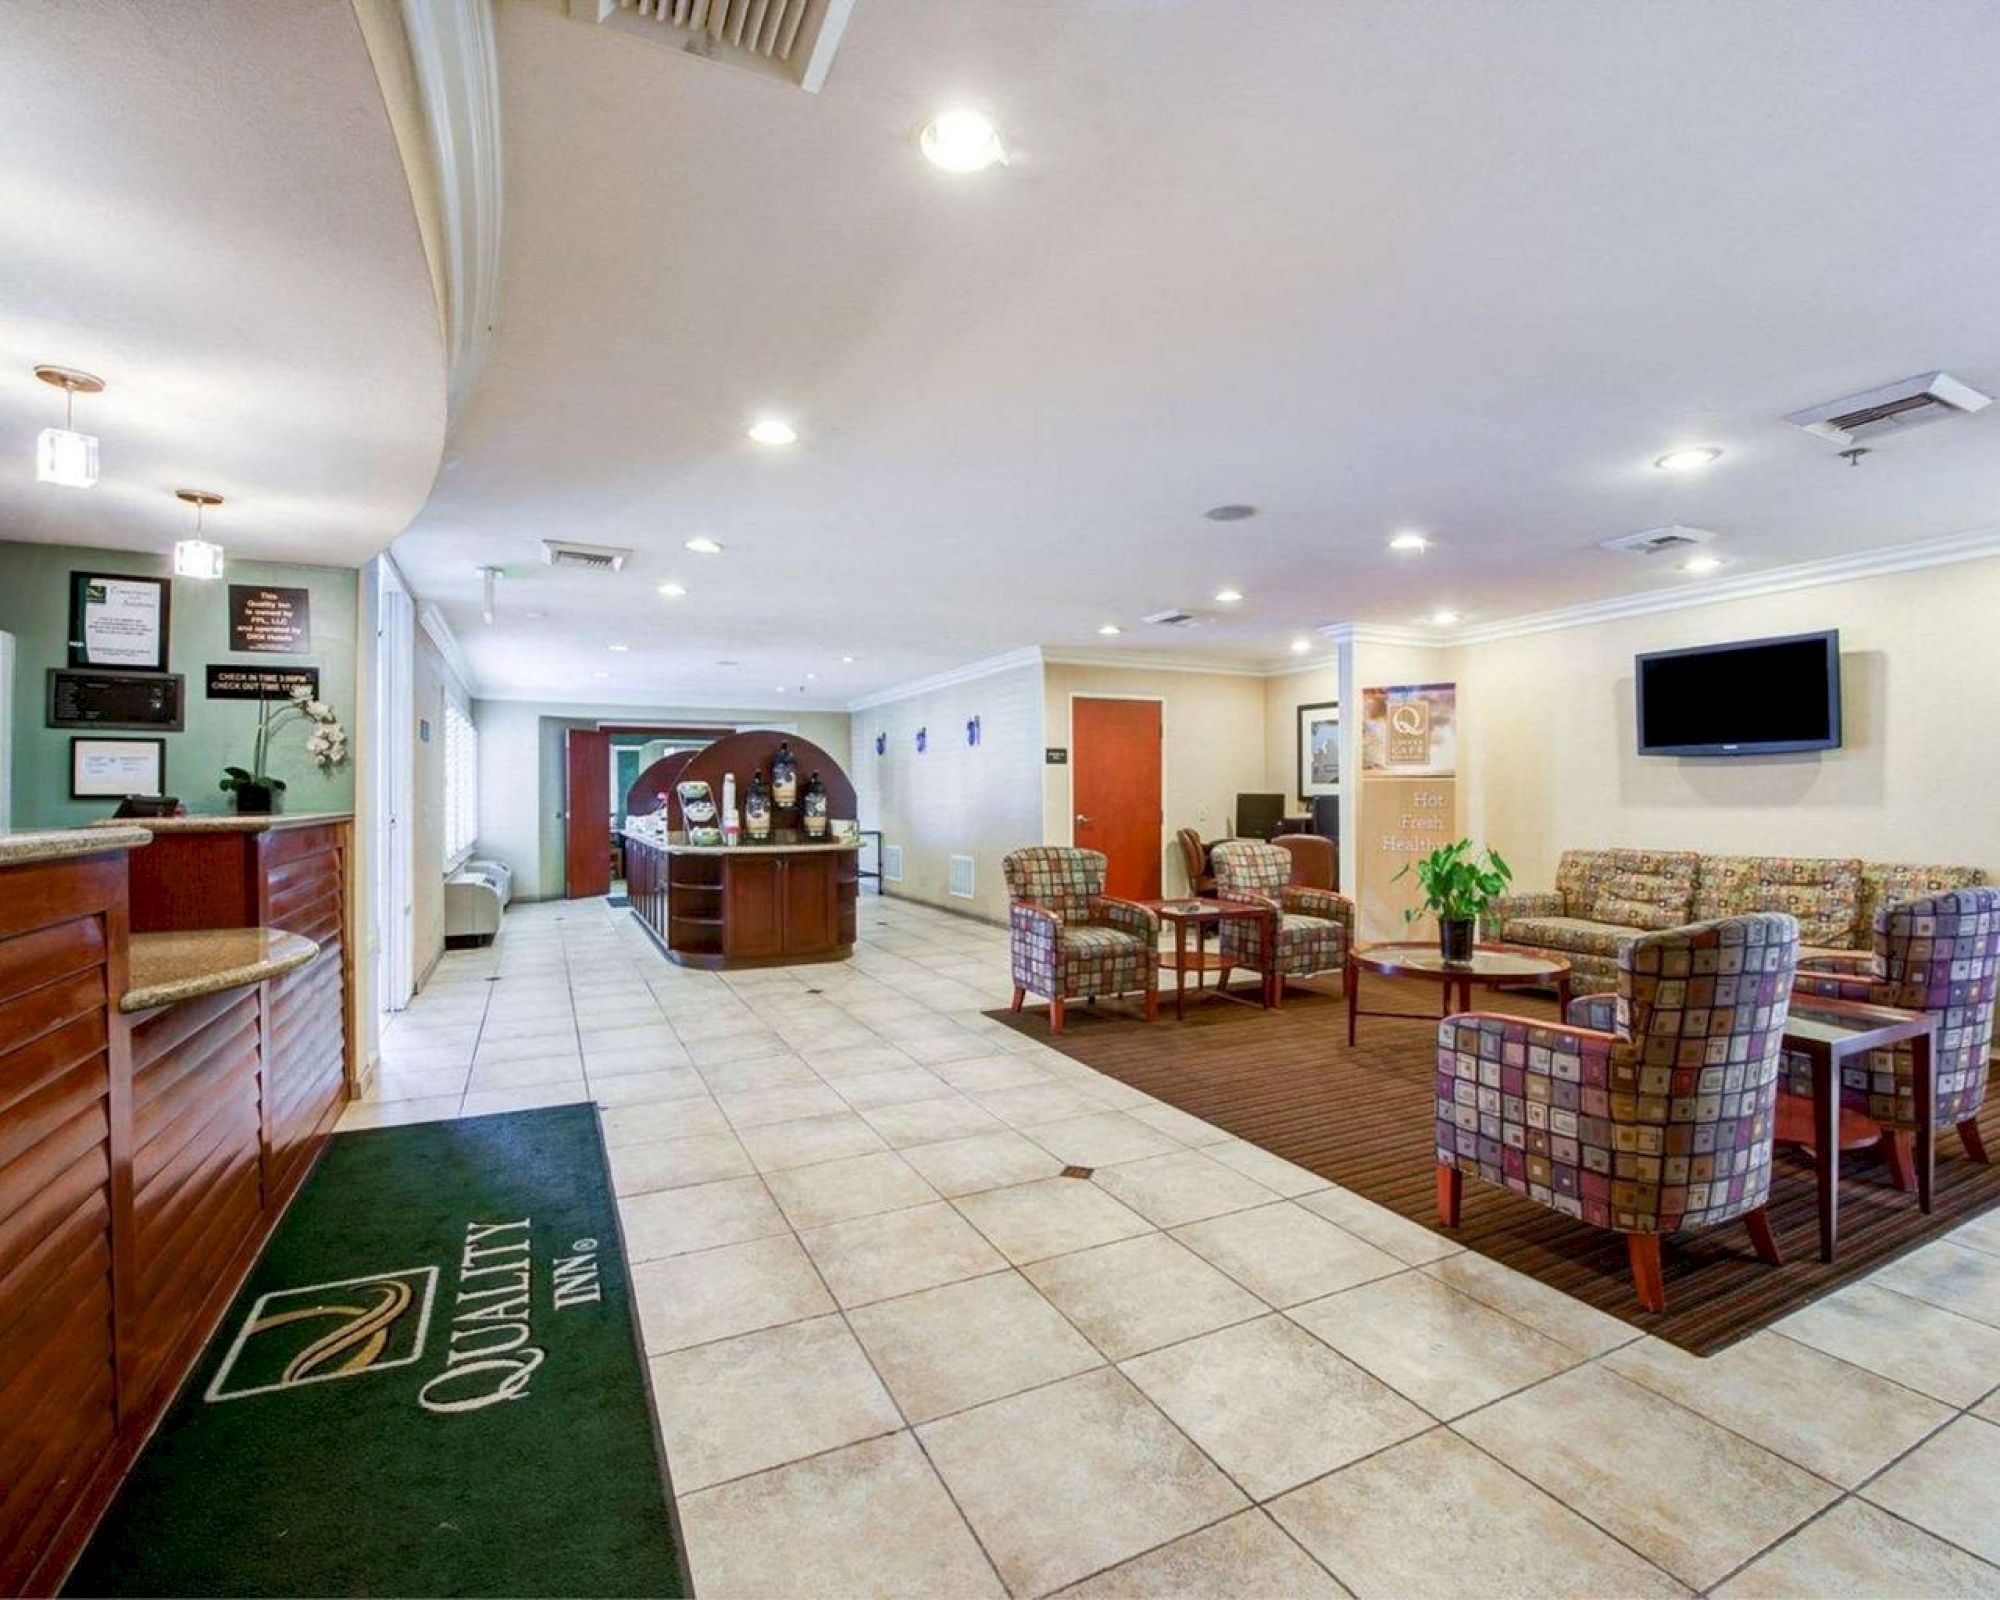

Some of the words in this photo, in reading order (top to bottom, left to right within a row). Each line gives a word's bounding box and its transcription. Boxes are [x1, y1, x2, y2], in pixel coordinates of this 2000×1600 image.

[218, 672, 247, 681] CHECK
[248, 674, 258, 682] IN
[259, 674, 278, 682] TIME
[211, 680, 240, 690] CHECK
[241, 682, 259, 691] OUT
[419, 1217, 545, 1413] QUALITY
